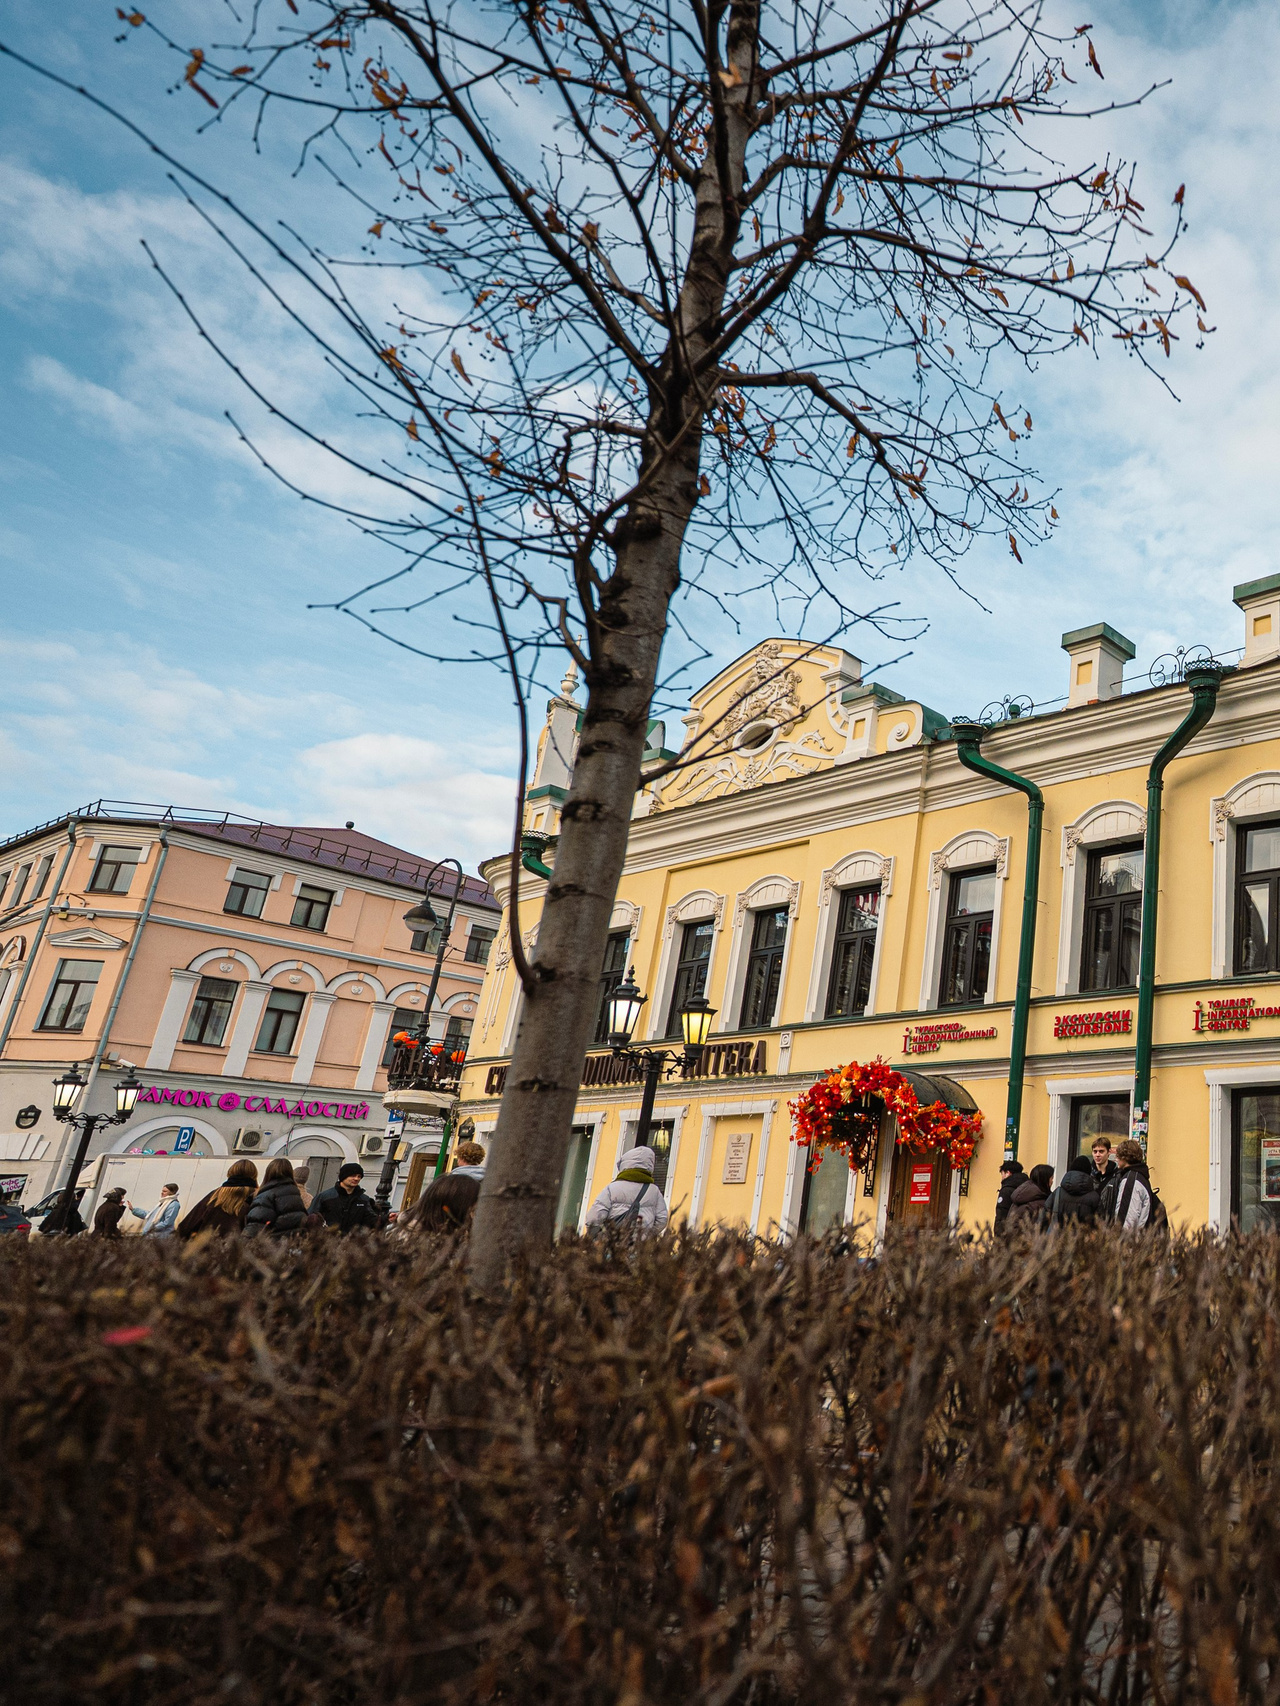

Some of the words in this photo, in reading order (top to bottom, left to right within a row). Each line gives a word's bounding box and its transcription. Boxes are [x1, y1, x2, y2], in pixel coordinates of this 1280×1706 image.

[1207, 997, 1254, 1010] TOURIST
[1054, 1009, 1132, 1026] ЭКСКУРСИИ
[1207, 1018, 1249, 1031] CENTRE
[912, 1026, 997, 1043] ИНФОРМАЦИОННЫЙ
[1053, 1020, 1131, 1037] EXCURSIONS
[911, 1042, 939, 1054] ЦЕНТР
[137, 1084, 215, 1108] АМОК
[244, 1095, 371, 1120] СЛАДОСТЕЙ
